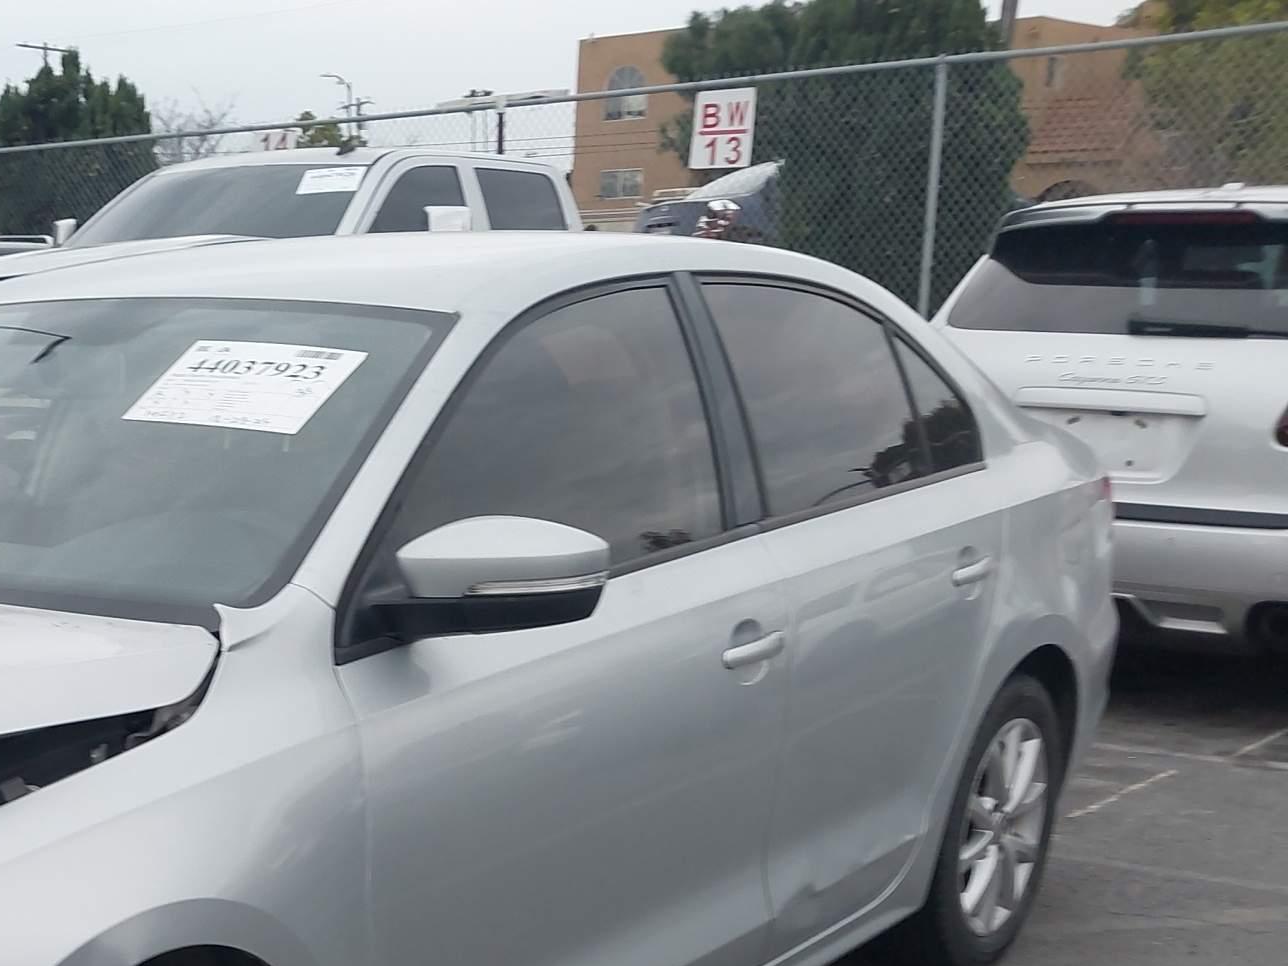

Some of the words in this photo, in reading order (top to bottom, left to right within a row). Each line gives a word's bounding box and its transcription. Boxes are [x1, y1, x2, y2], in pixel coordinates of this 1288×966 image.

[702, 101, 750, 129] BW
[261, 132, 288, 151] 14
[704, 136, 742, 166] 13
[187, 358, 325, 380] 44037923
[1026, 355, 1217, 370] PORSCHE
